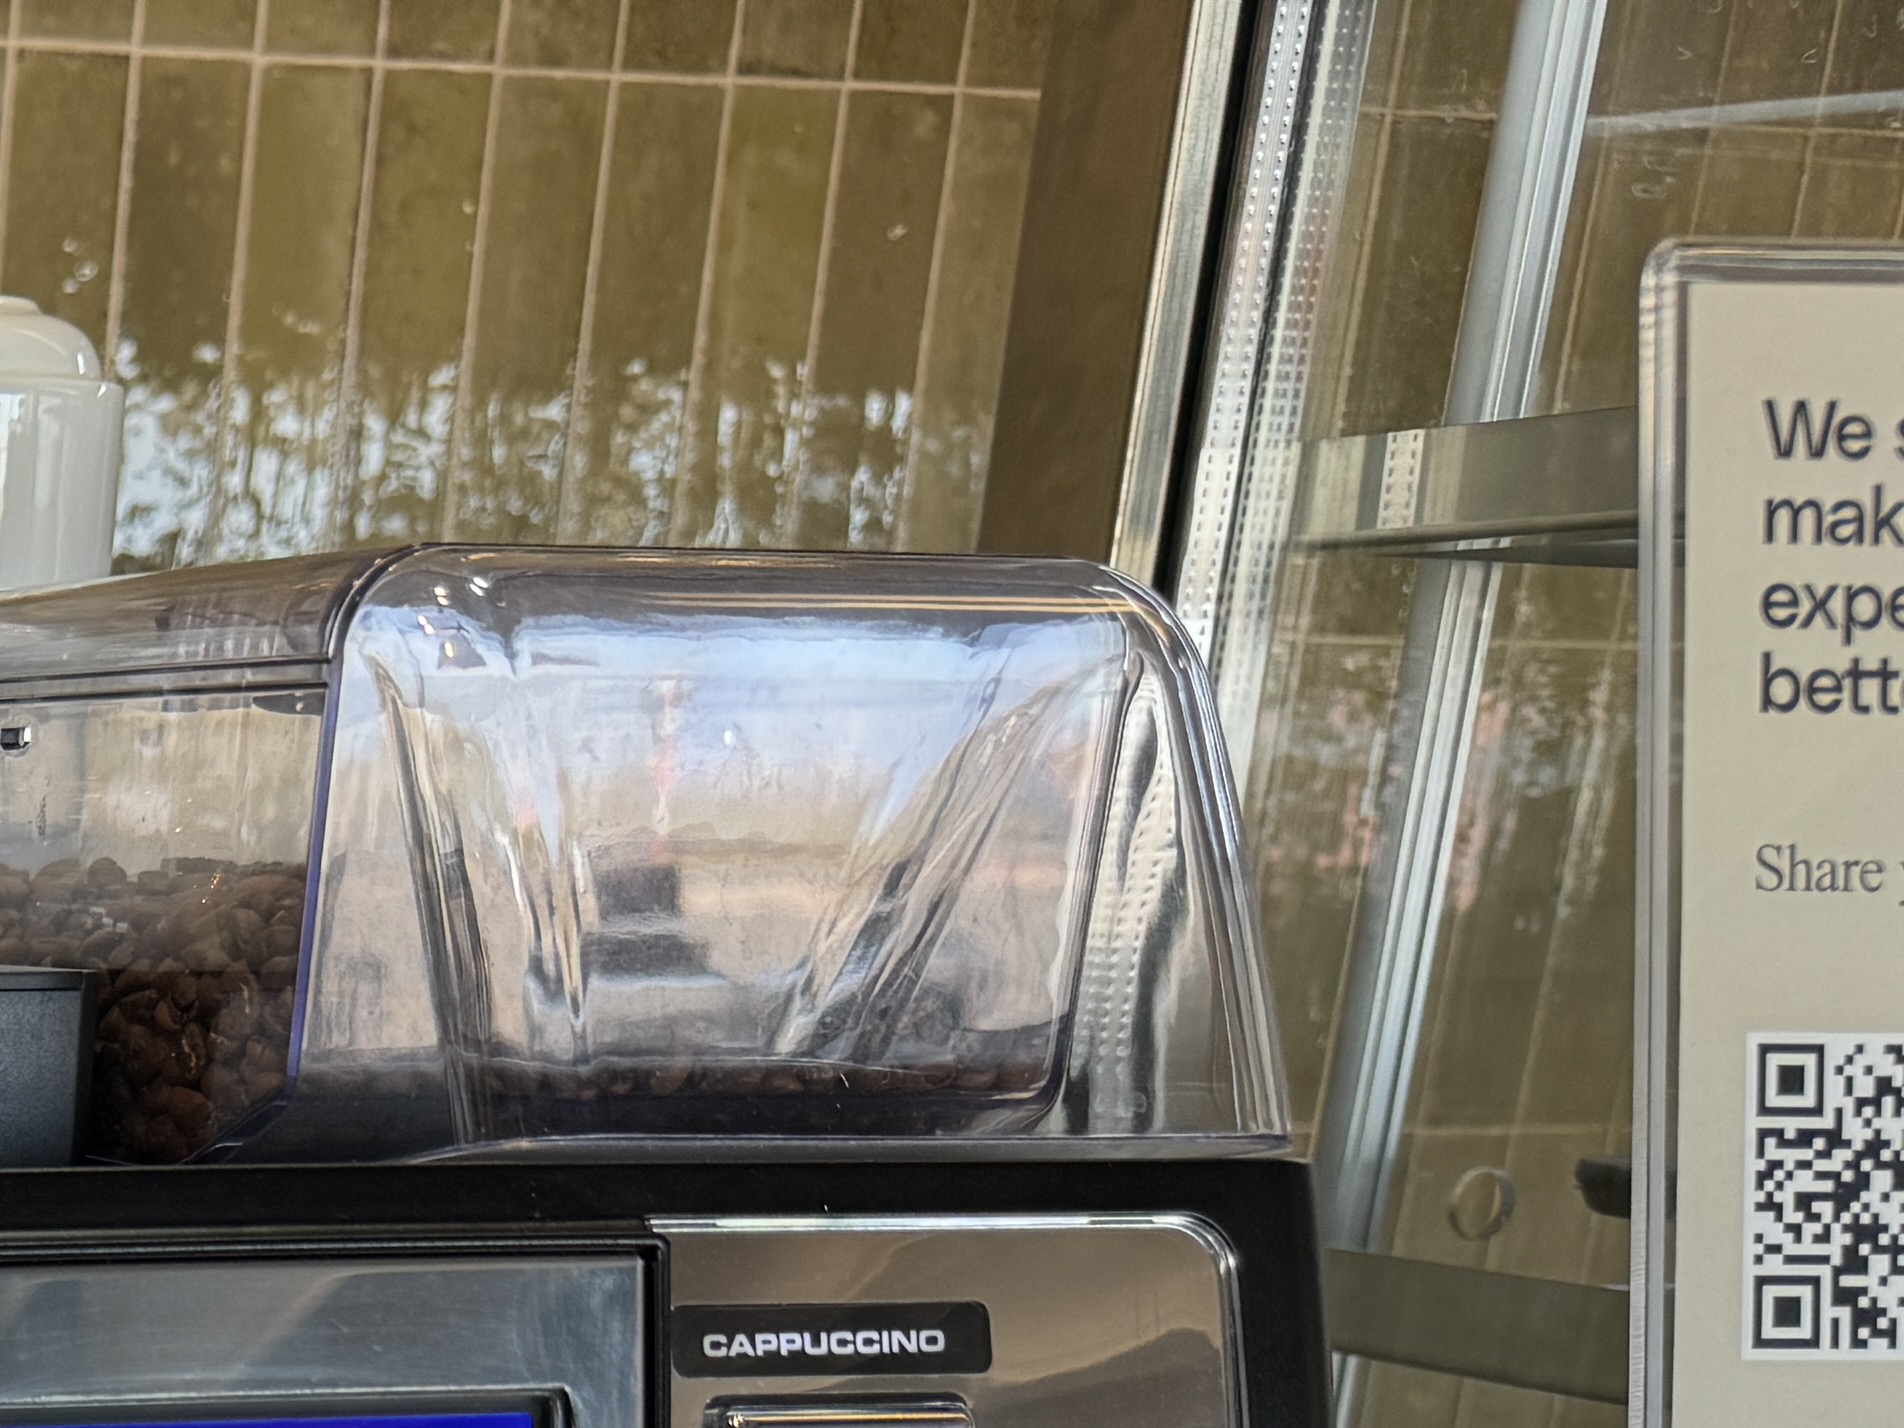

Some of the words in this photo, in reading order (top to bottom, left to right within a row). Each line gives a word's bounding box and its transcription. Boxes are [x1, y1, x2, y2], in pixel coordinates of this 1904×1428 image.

[1761, 398, 1874, 461] We
[1759, 651, 1904, 716] bett
[1756, 843, 1884, 893] Share
[702, 1329, 946, 1358] CAPPUCCINO
